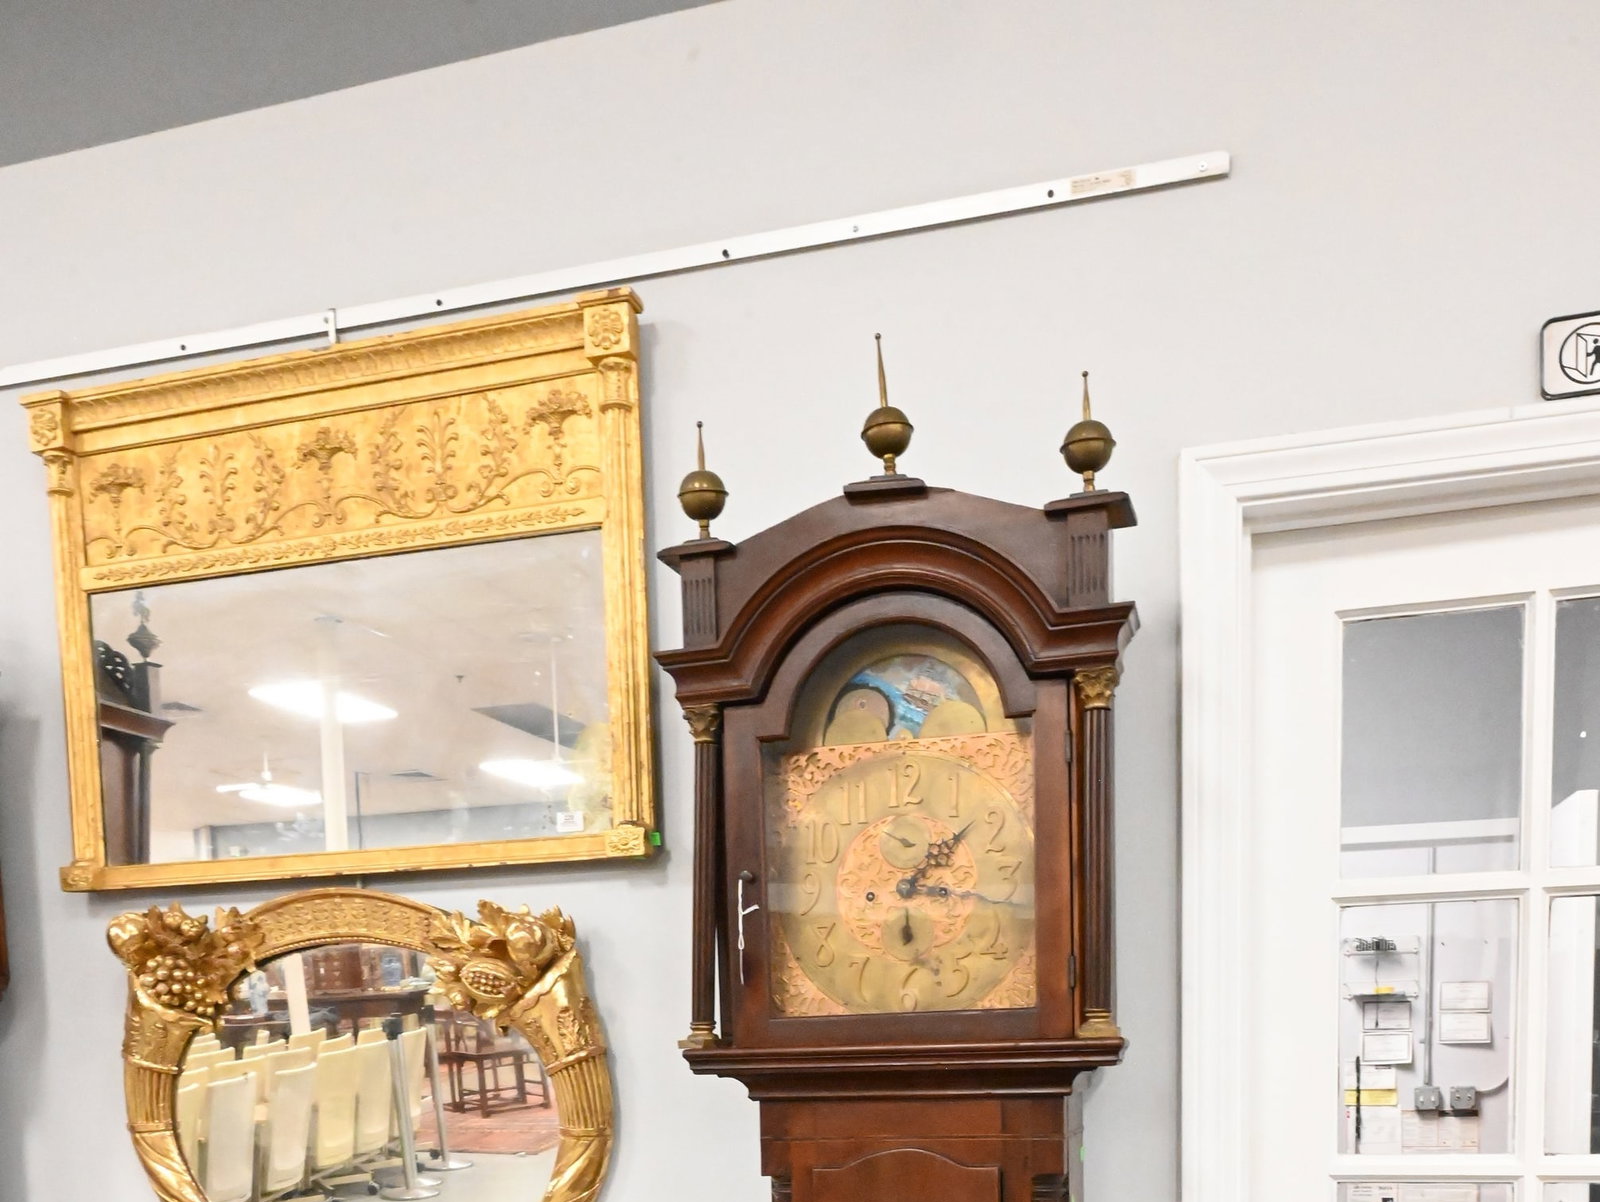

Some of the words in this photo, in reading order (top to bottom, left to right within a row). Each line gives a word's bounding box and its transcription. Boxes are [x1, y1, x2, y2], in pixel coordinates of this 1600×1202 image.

[841, 781, 868, 826] 11
[889, 763, 924, 809] 12
[947, 770, 961, 818] 1
[805, 819, 840, 866] 10
[984, 809, 1007, 855] 2
[801, 872, 821, 917] 9
[998, 860, 1023, 901] 3
[815, 922, 836, 968] 8
[848, 957, 871, 1003] 7
[901, 967, 920, 1012] 6
[945, 952, 972, 998] 5
